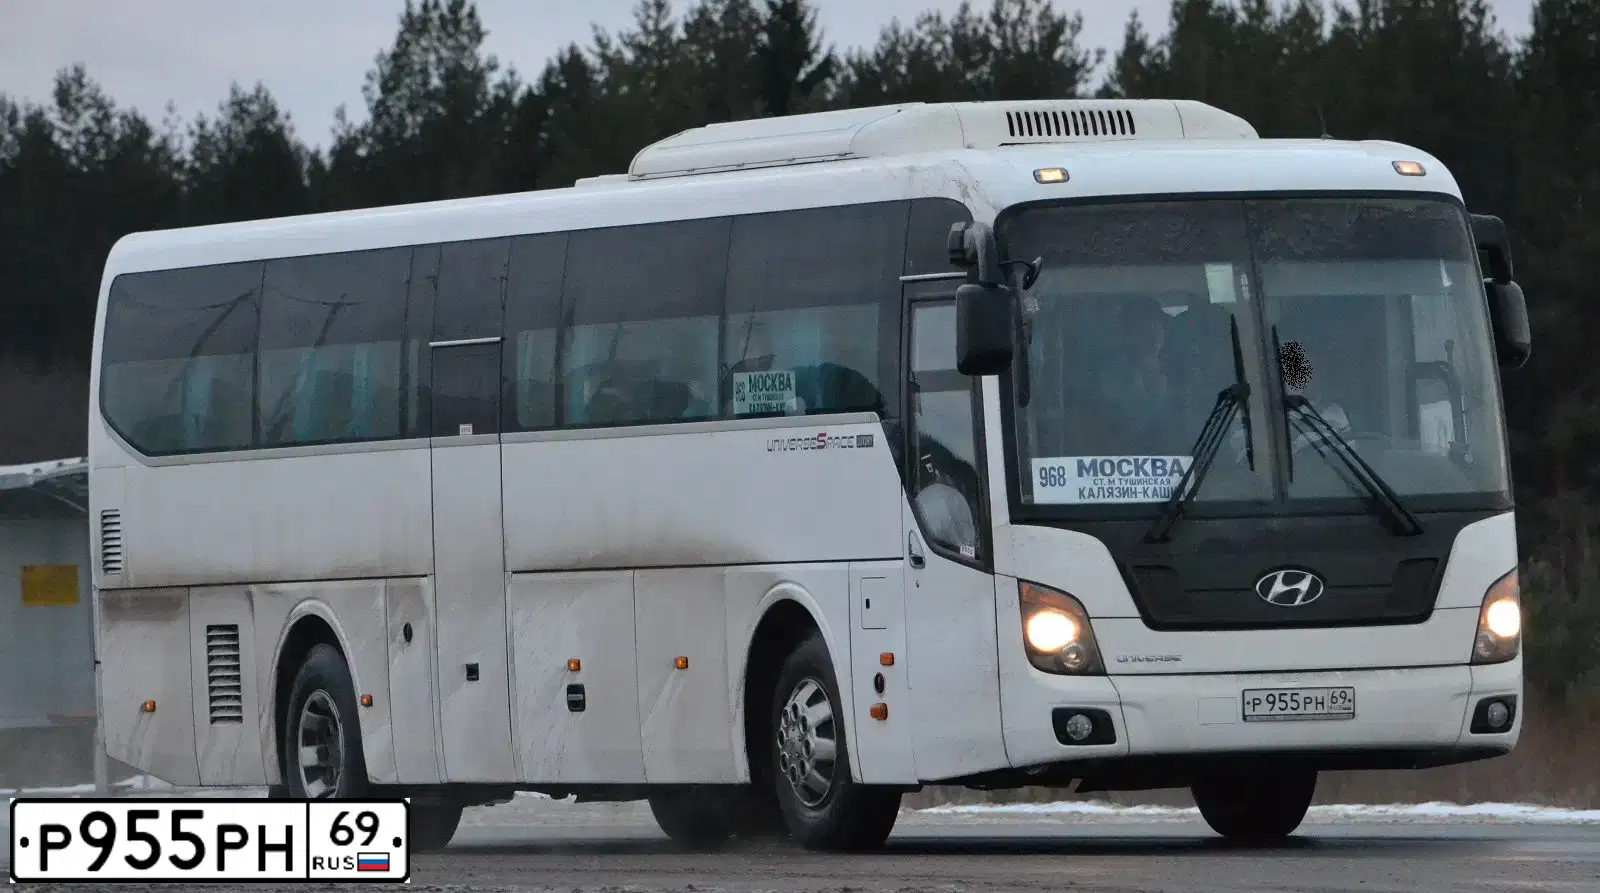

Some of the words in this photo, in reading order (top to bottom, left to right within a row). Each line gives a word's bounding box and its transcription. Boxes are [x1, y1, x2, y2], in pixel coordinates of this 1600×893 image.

[749, 373, 792, 393] МОСКВА
[1039, 466, 1066, 487] 968
[1077, 458, 1185, 478] МОСКВА
[1119, 477, 1171, 486] ТУШИНСКАЯ
[1116, 654, 1183, 663] UNIVERSE
[1330, 690, 1347, 705] 69
